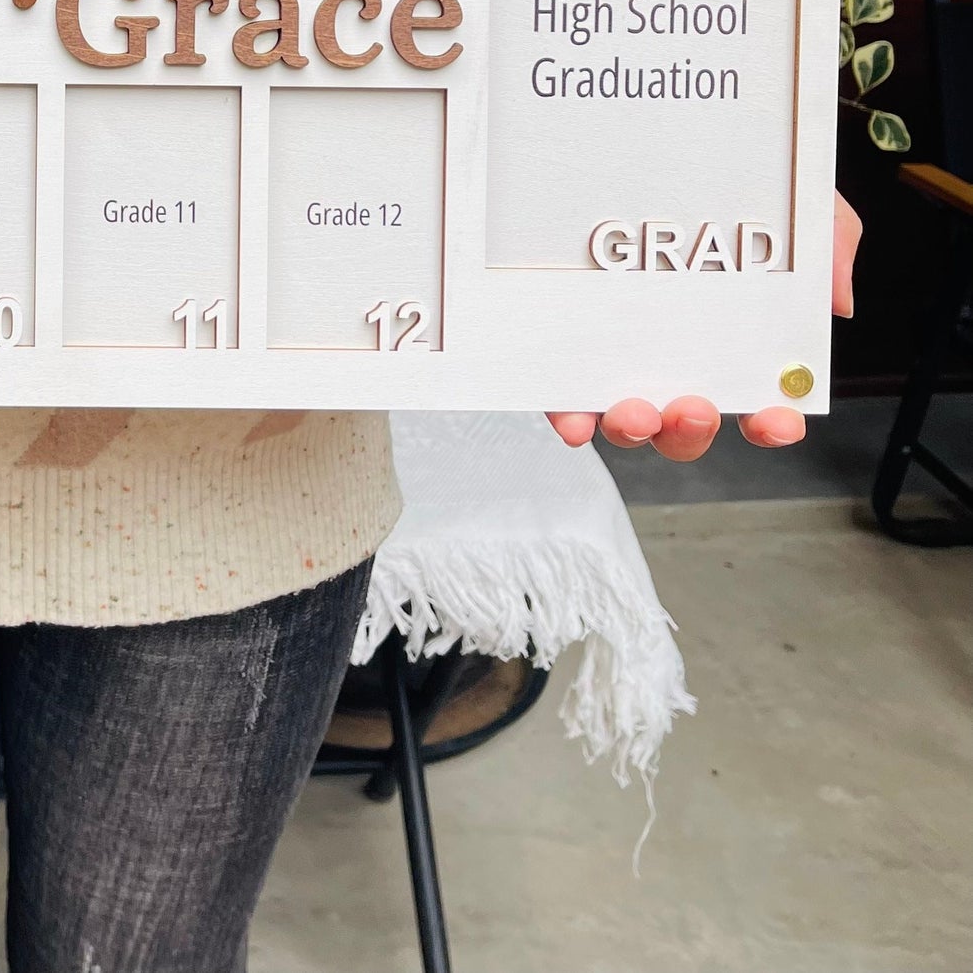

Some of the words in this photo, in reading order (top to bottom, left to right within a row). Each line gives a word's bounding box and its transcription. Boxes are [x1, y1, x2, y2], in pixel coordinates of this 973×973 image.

[531, 56, 739, 100] Graduation
[103, 198, 167, 224] Grade
[174, 200, 196, 224] 11
[306, 201, 371, 227] Grade
[378, 203, 402, 227] 12
[587, 219, 784, 272] GRAD
[172, 297, 228, 348] 11
[365, 299, 428, 351] 12
